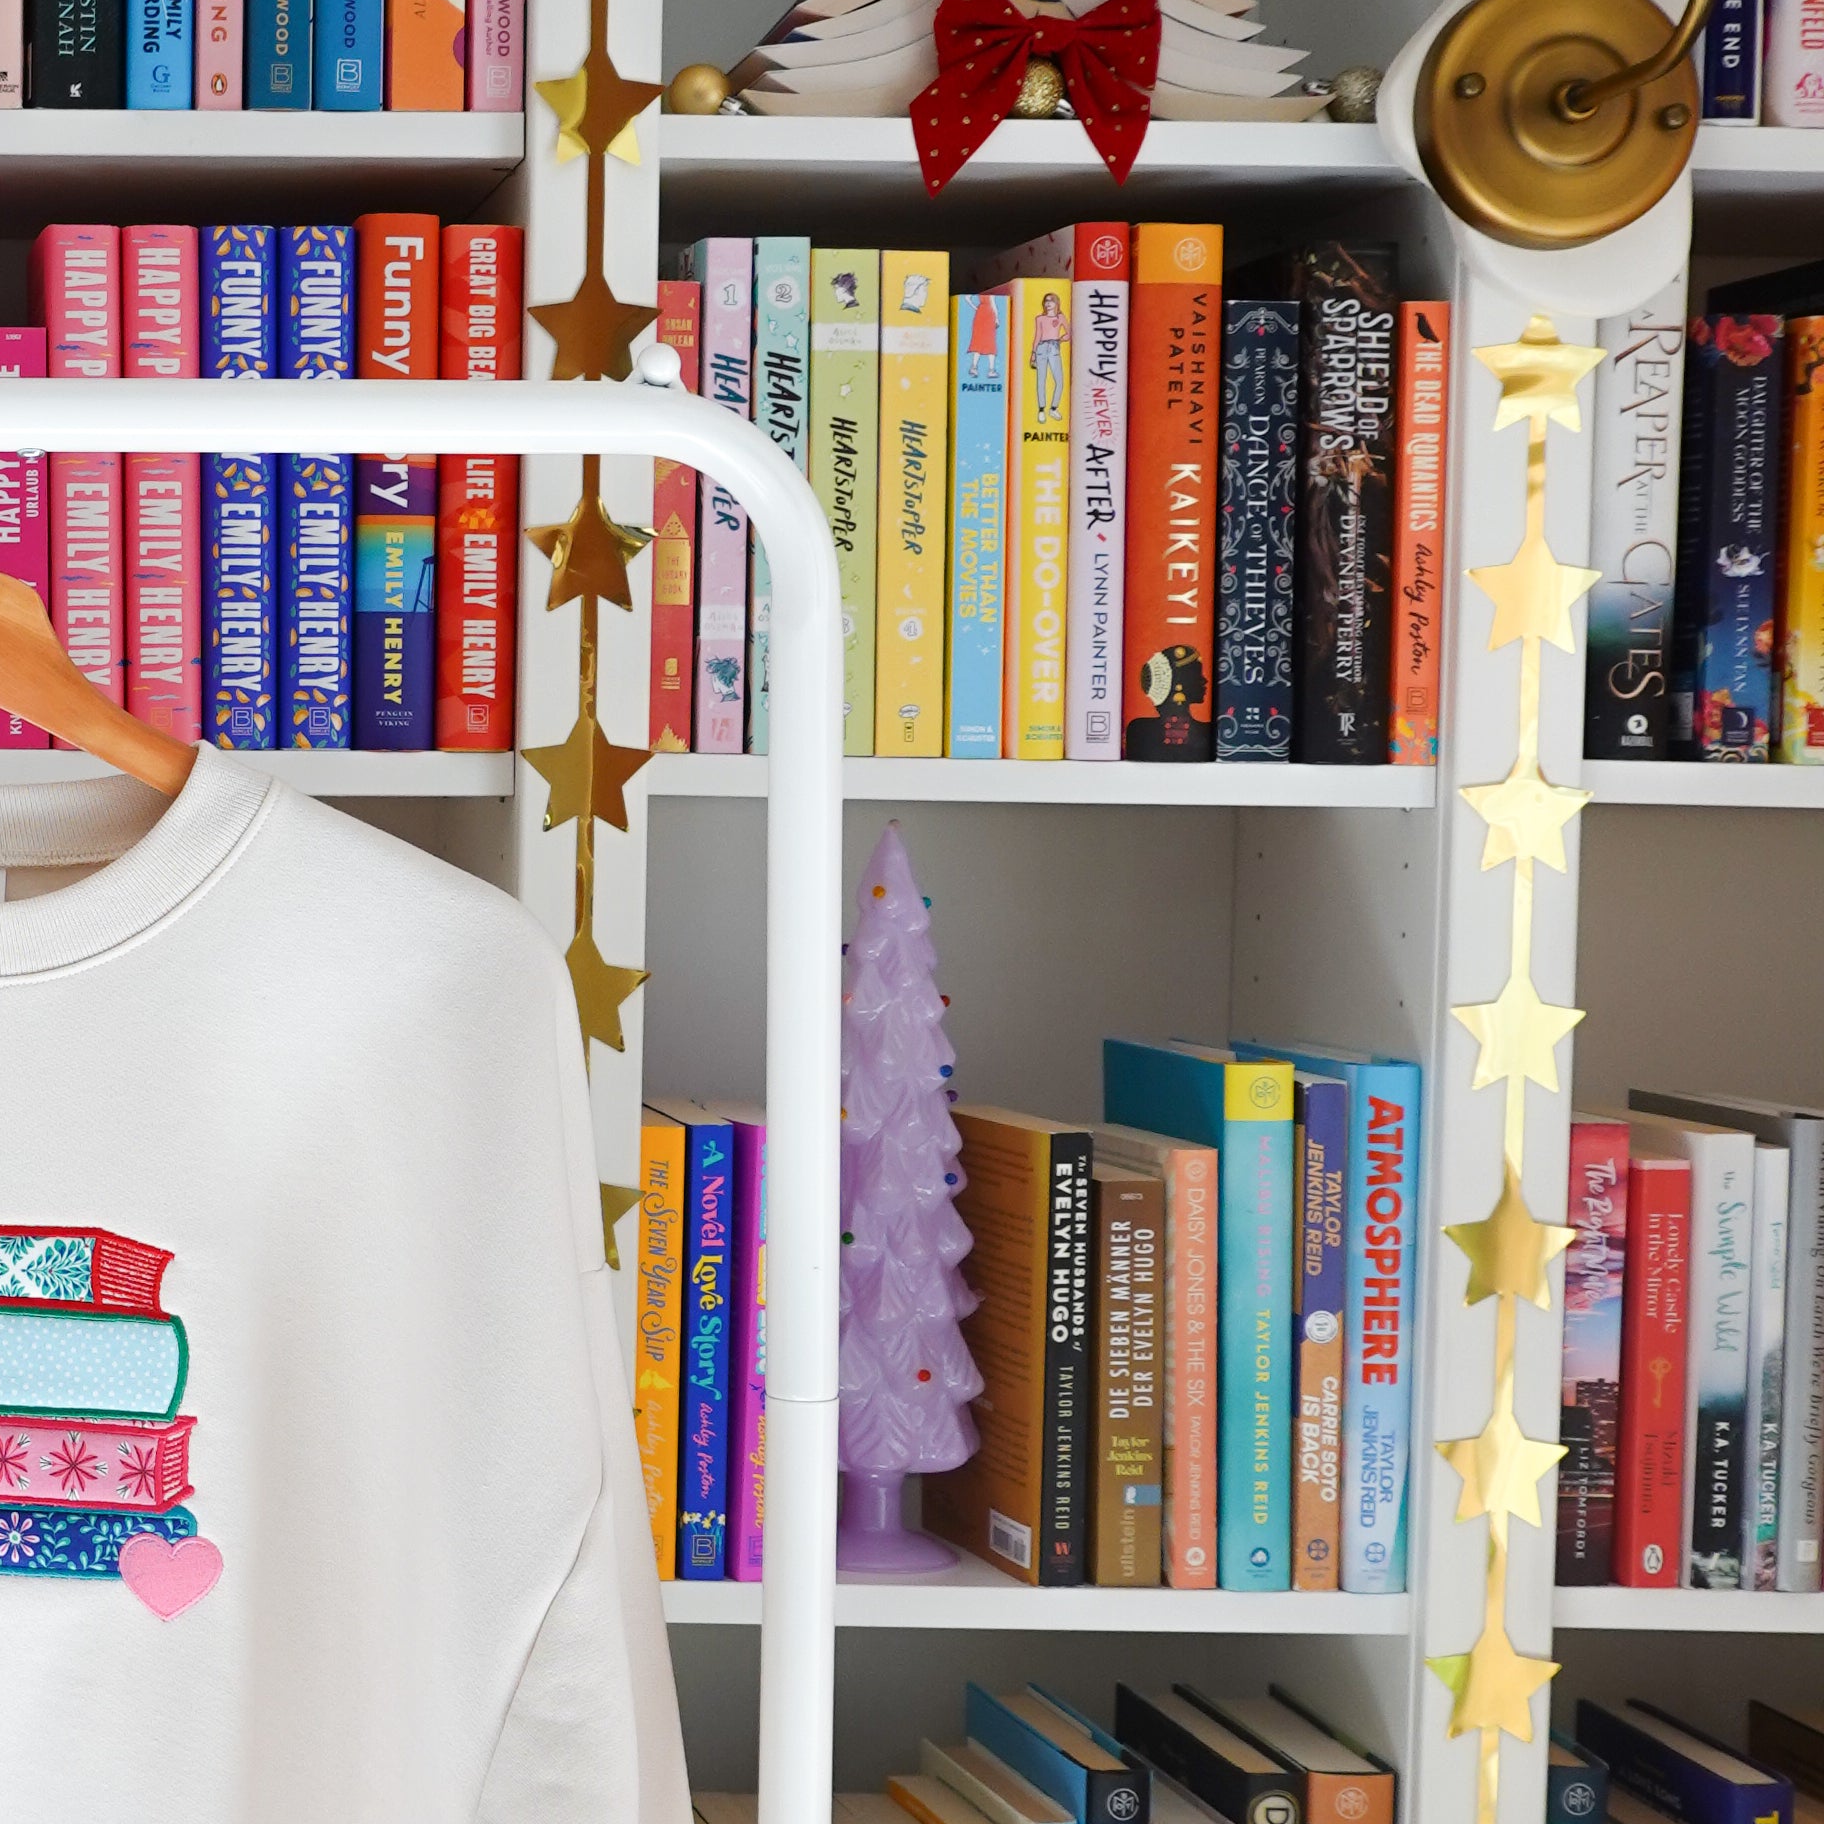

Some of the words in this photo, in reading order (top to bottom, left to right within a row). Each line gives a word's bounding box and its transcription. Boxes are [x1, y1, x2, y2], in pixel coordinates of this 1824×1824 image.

[220, 261, 262, 358] FUNNY
[371, 236, 425, 374] Funny
[1033, 458, 1062, 525] THE
[1093, 553, 1109, 607] LYNN
[1165, 465, 1202, 627] KAIKEYI
[1027, 536, 1062, 706] DO-OVER
[1090, 612, 1109, 701] PAINTER
[375, 710, 414, 718] PENGUIN
[378, 719, 412, 727] VIKING
[1052, 1162, 1072, 1260] EVELYN
[1360, 1095, 1404, 1386] ATMOSPHERE
[1051, 1270, 1069, 1344] HUGO
[1710, 1458, 1729, 1529] TUCKER
